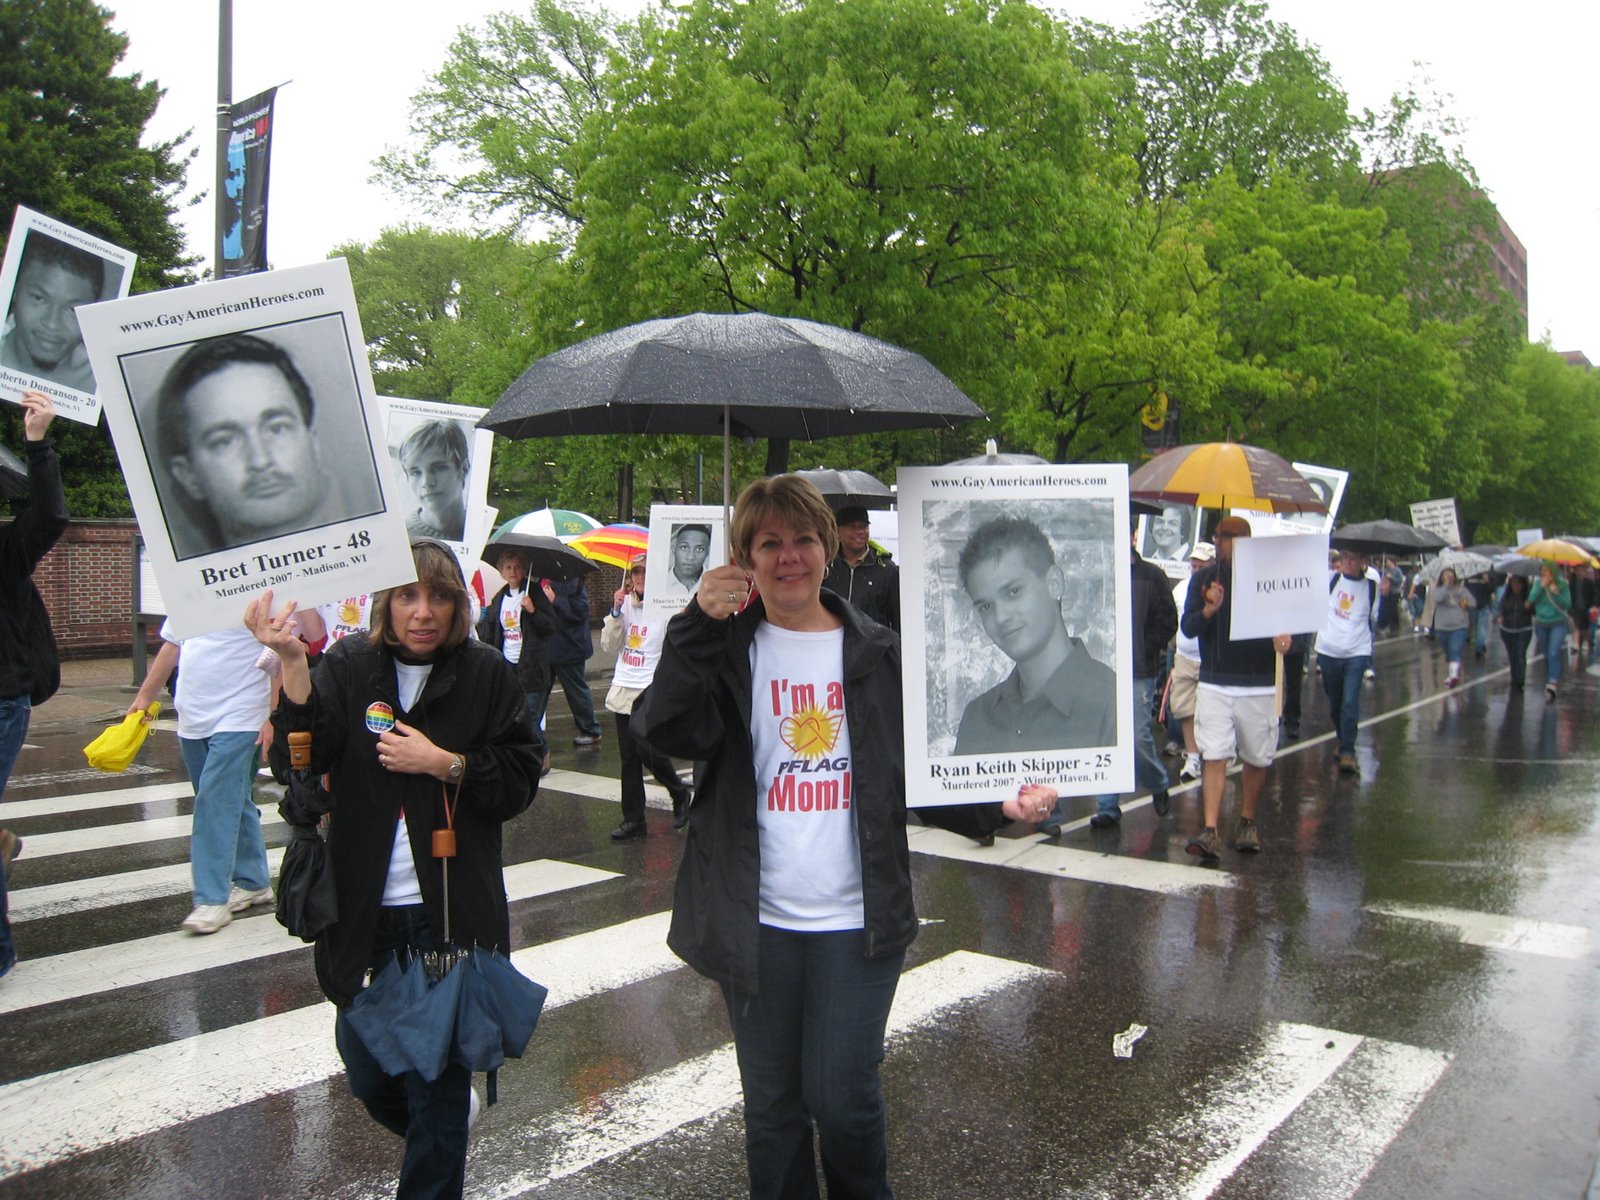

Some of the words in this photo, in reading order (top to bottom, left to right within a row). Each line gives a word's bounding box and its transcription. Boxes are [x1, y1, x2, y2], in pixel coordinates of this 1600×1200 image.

[32, 218, 126, 261] www.GayAmericanHeroes.com
[120, 286, 325, 334] www.GayAmericanHeroes.com
[0, 371, 28, 386] oberto
[30, 379, 79, 404] Duncanson
[86, 397, 96, 408] 20
[389, 403, 481, 418] www.GayAmericanHeroes.com
[931, 476, 1107, 490] www.GayAmericanHeroes.com
[200, 561, 249, 586] Bret
[252, 544, 326, 573] Turner
[347, 530, 371, 549] 48
[460, 546, 469, 555] 21
[215, 578, 268, 599] Murdered
[270, 572, 293, 586] 2007
[302, 560, 349, 577] Madison,
[350, 554, 367, 565] WI
[1257, 576, 1311, 594] EQUALITY
[335, 624, 368, 633] PFLAG
[622, 651, 645, 667] Mom!
[771, 678, 815, 716] I'm
[826, 681, 843, 710] a
[778, 757, 849, 775] PFLAG
[930, 764, 970, 781] Ryan
[976, 758, 1016, 776] Keith
[1021, 756, 1080, 774] Skipper
[1095, 754, 1112, 768] 25
[767, 771, 851, 812] Mom!
[942, 779, 990, 791] Murdered
[993, 777, 1015, 788] 2007
[1024, 774, 1056, 785] Winter
[1060, 773, 1091, 784] Haven,
[1095, 771, 1108, 781] FL
